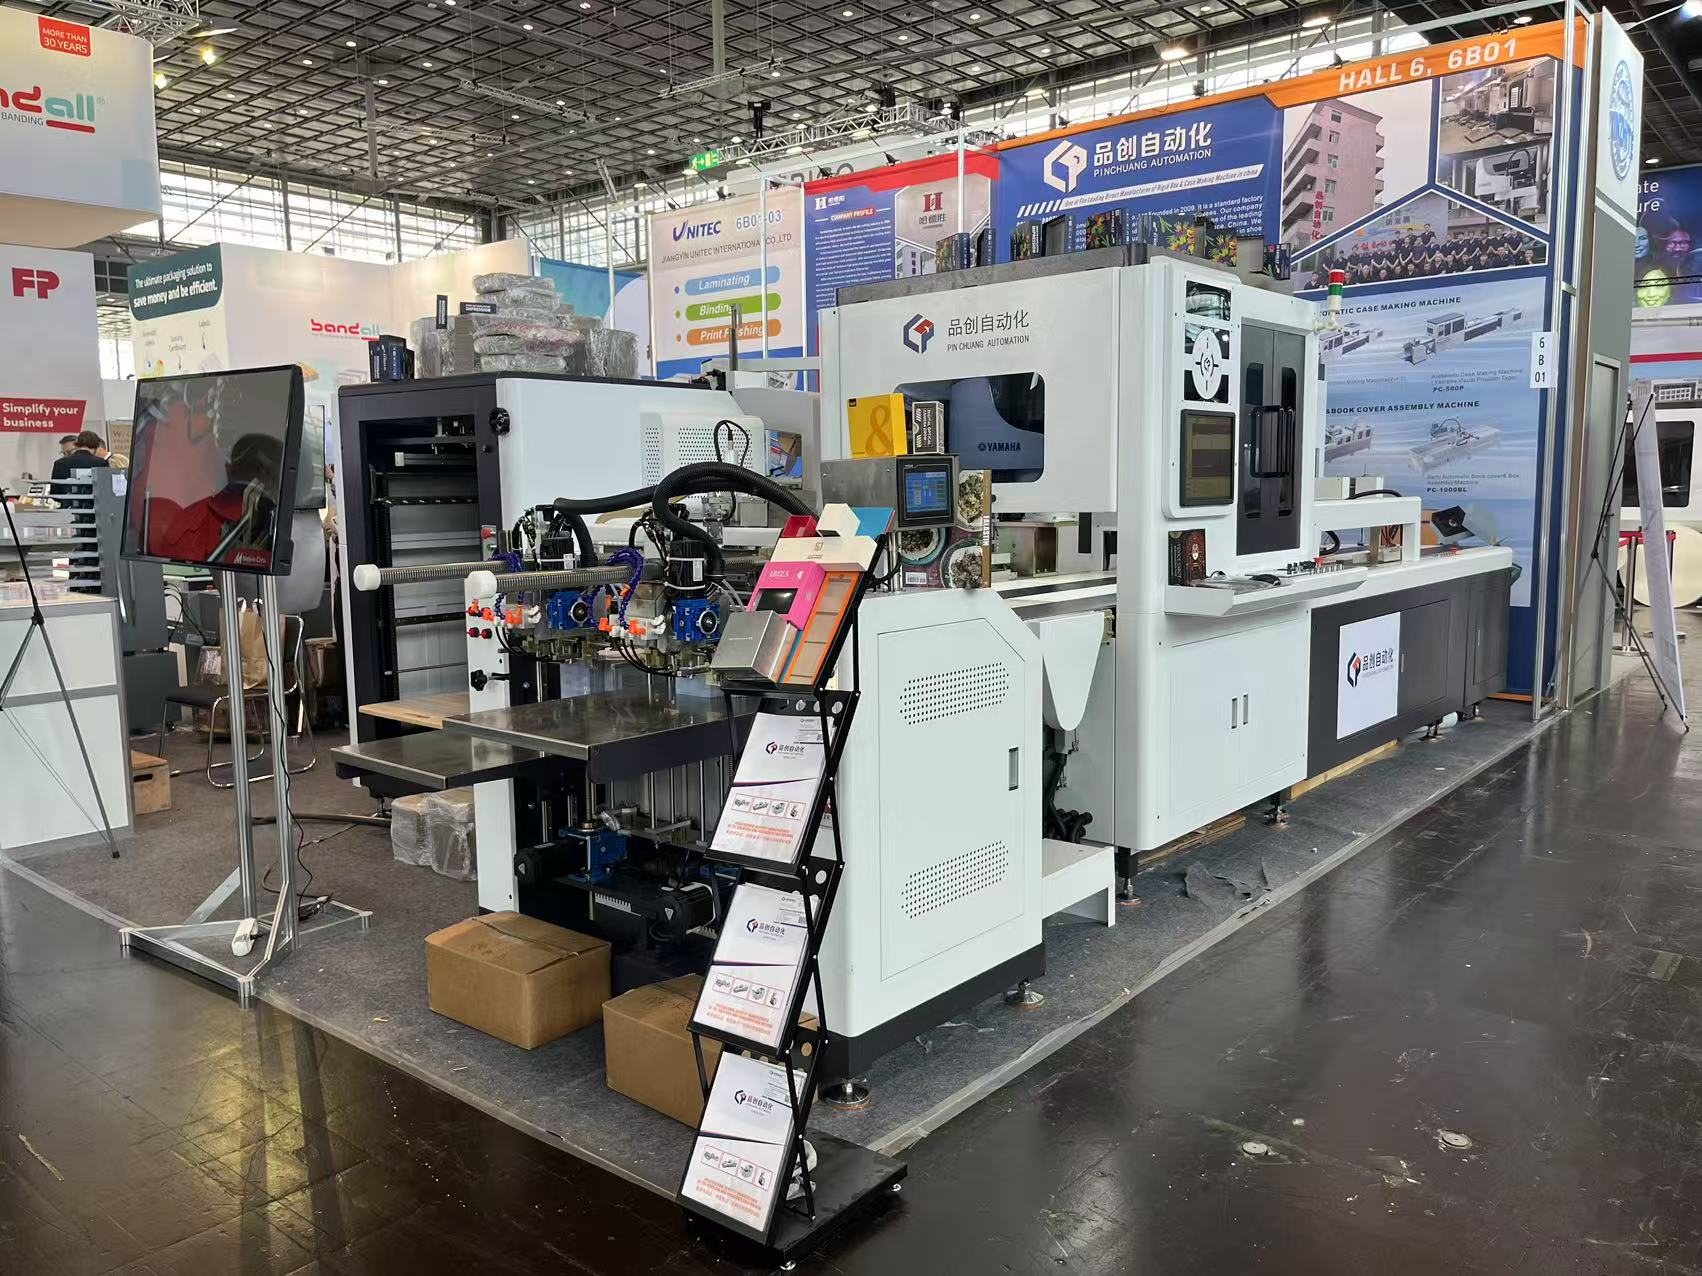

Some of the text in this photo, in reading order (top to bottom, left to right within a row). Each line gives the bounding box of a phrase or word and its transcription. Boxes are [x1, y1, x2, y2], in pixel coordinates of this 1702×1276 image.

[43, 28, 87, 42] MORE THAN
[44, 37, 88, 53] 30 YEARS
[1338, 37, 1518, 92] HALL 6, 6B01
[1, 112, 44, 126] BANDING
[1094, 121, 1213, 166] 品创自动化
[1093, 148, 1212, 177] PINCHUANG AUTOMATION
[1214, 198, 1241, 208] standard
[1241, 195, 1264, 205] factory
[1233, 203, 1263, 213] company
[830, 208, 874, 222] COMPANY PROFILE
[1238, 210, 1263, 219] leading
[672, 219, 721, 241] UNITEC
[662, 253, 690, 264] JIANGYIN
[690, 247, 712, 259] UNITEC
[713, 238, 764, 254] INTERNATIONA
[135, 263, 213, 288] The ultimate packaging solution to
[699, 273, 751, 290] Laminating
[133, 297, 147, 308] save
[147, 291, 168, 304] money
[168, 286, 180, 300] and
[180, 284, 189, 297] be
[1356, 305, 1379, 314] CASE
[1380, 301, 1417, 311] MAKING
[1418, 296, 1461, 307] MACHINE
[311, 318, 380, 337] bandall
[948, 309, 1030, 337] 品创自动化
[700, 329, 722, 342] Print
[1540, 336, 1545, 348] 6
[947, 334, 1030, 352] PIN CHUANG AUTOMATION
[1538, 354, 1545, 365] B
[1535, 371, 1545, 383] 01
[1432, 385, 1464, 393] PC-500P
[2, 402, 79, 416] Simplify your
[1357, 405, 1386, 413] COVER
[1387, 402, 1435, 411] ASSEMBLY
[1436, 400, 1480, 409] MACHINE
[3, 417, 54, 428] business
[988, 442, 1021, 451] YAMAHA
